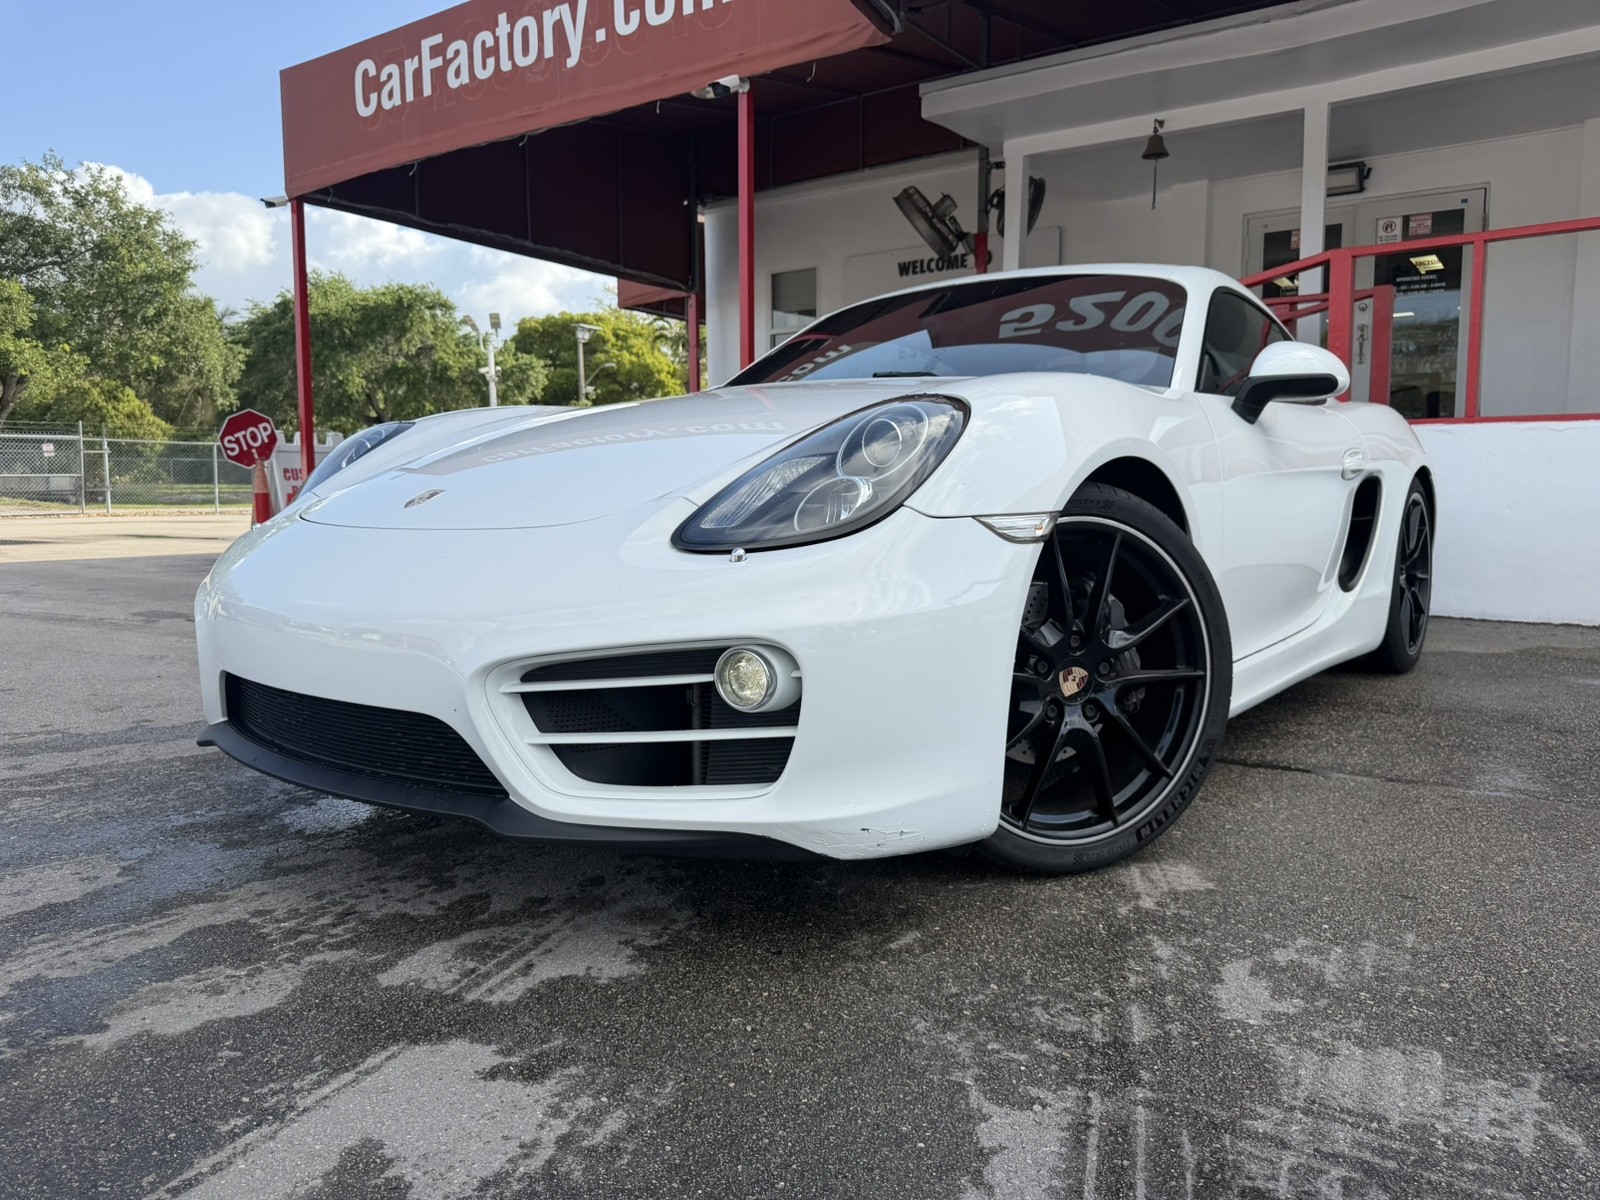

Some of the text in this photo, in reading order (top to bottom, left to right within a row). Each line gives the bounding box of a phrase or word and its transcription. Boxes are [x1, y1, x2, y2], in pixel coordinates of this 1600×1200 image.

[897, 252, 968, 278] WELCOME
[223, 421, 273, 457] STOP
[1139, 761, 1206, 840] MICHELIN
